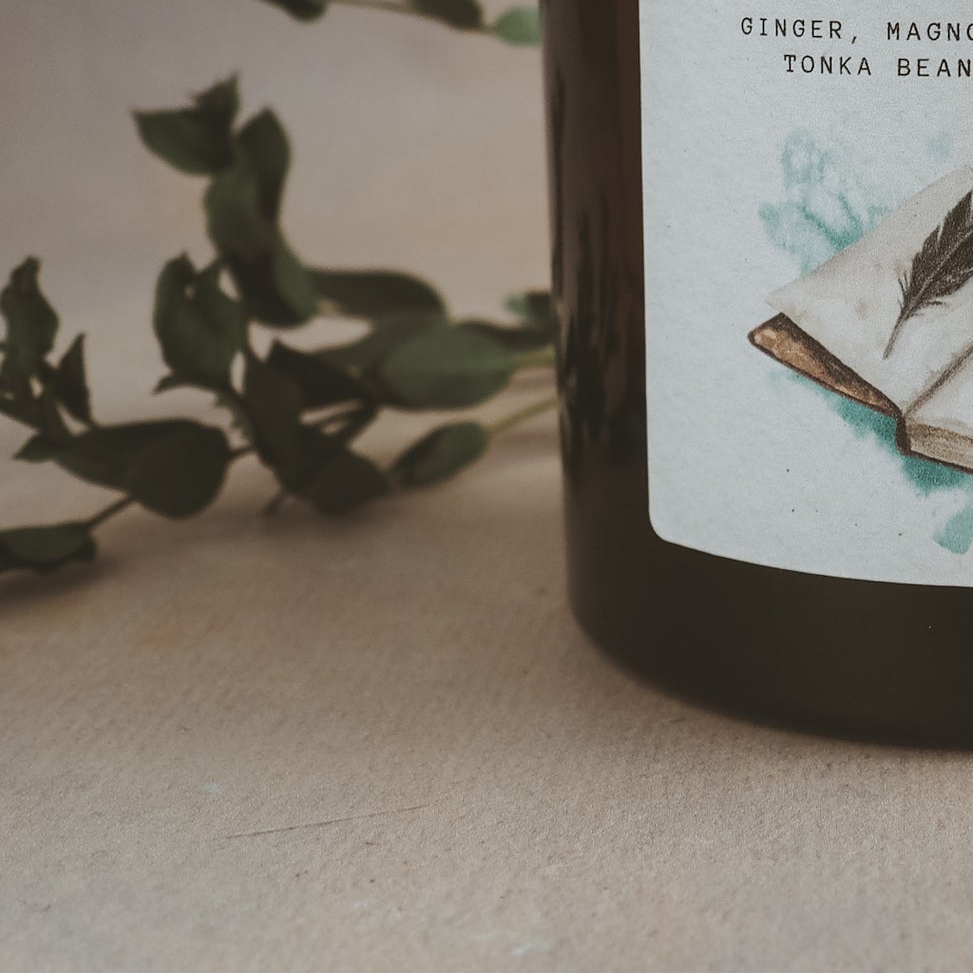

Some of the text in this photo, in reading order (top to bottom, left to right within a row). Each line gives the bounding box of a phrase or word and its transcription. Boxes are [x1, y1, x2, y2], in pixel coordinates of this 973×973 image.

[740, 16, 857, 45] GINGER,
[783, 53, 872, 76] TONKA
[897, 57, 972, 78] BEAN
